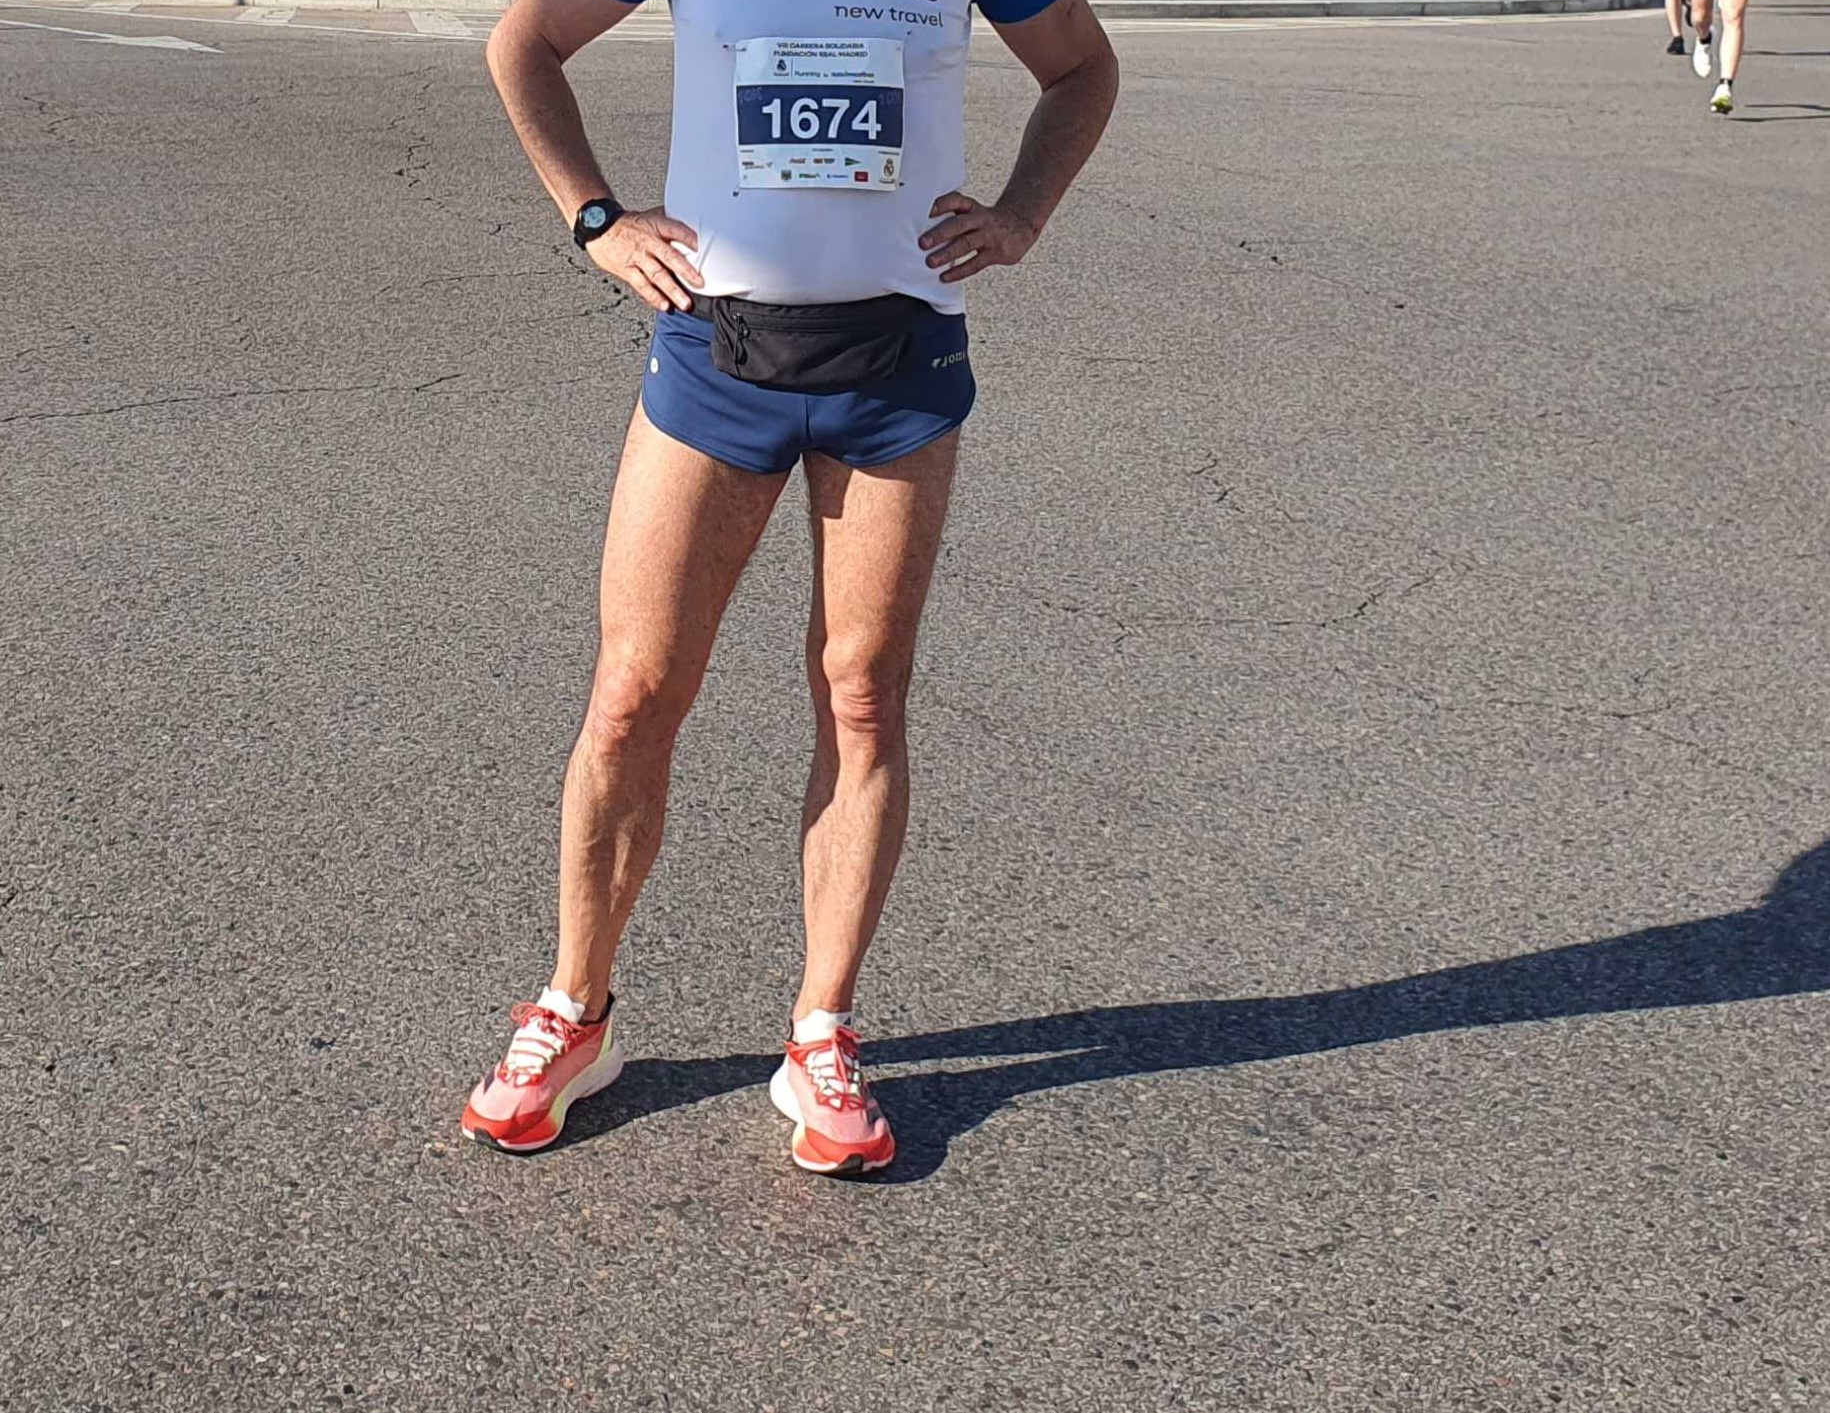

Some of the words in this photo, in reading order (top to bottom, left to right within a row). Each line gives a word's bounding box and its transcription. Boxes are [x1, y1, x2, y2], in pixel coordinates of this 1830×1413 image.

[834, 5, 884, 20] new
[889, 7, 944, 27] travel
[762, 97, 882, 140] 1674
